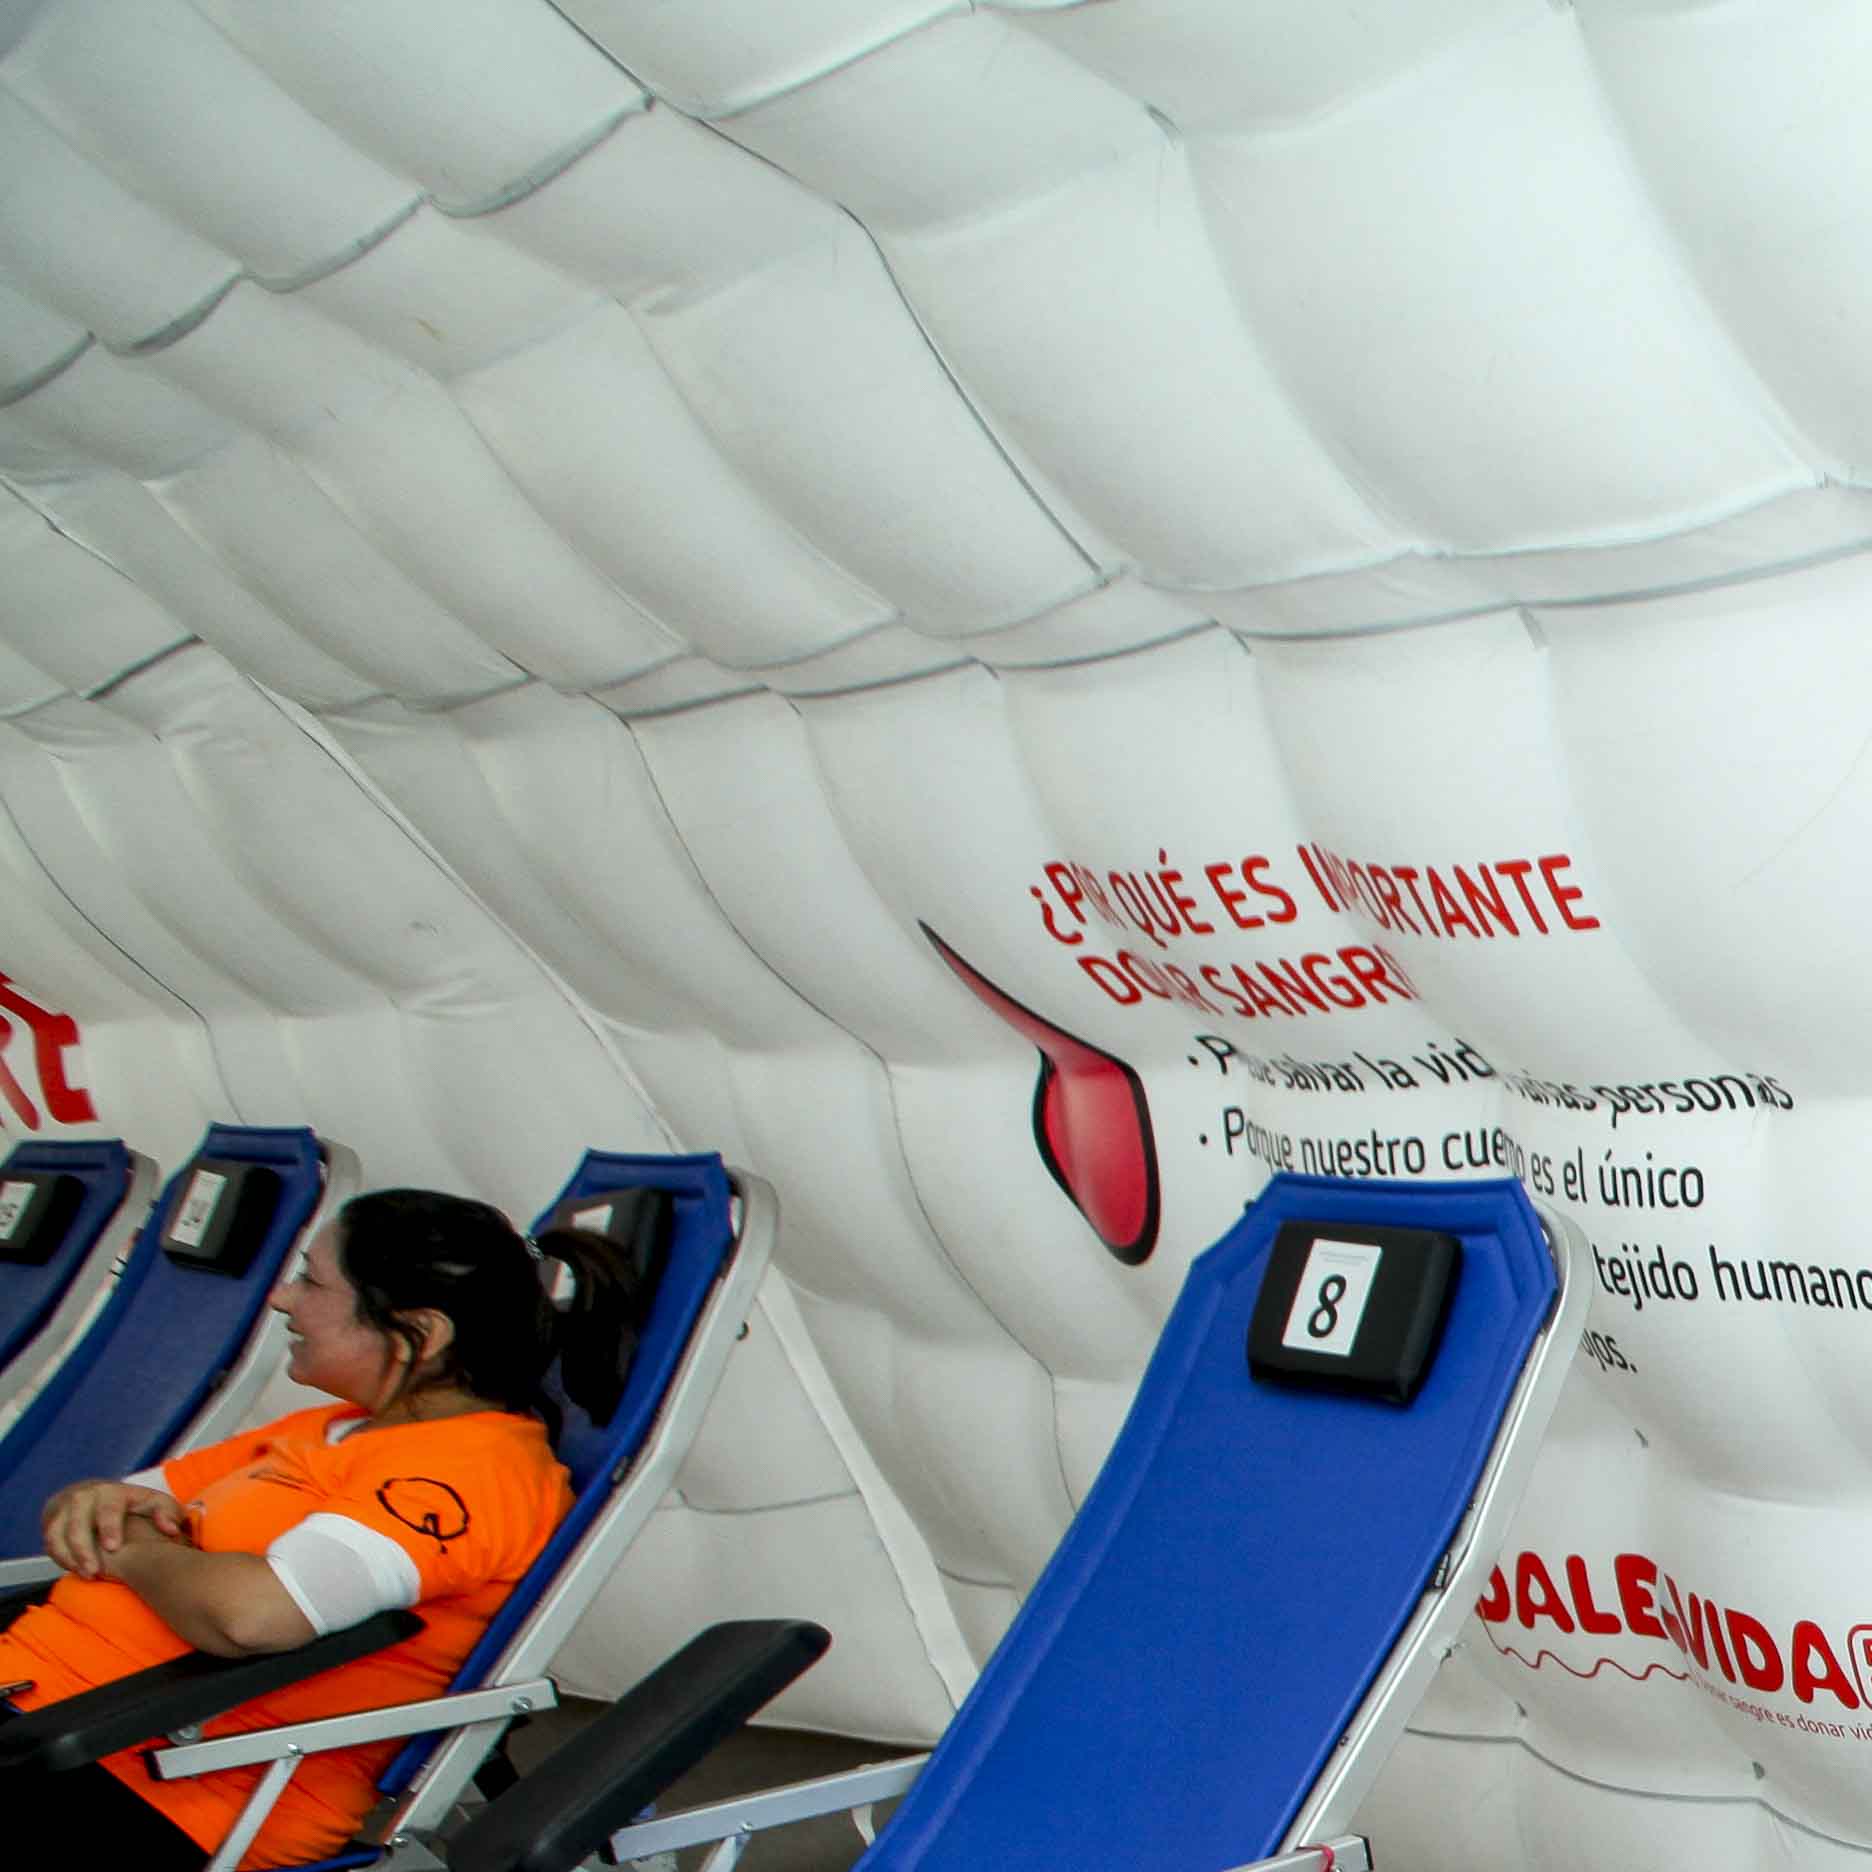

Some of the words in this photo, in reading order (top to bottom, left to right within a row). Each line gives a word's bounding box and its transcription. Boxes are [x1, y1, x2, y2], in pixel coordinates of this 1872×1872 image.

[1204, 855, 1298, 929] ES
[1352, 1051, 1420, 1090] la
[1412, 1038, 1500, 1084] vid
[1592, 1073, 1794, 1129] personas
[1300, 1128, 1426, 1176] nuestro
[1530, 1152, 1555, 1196] es
[1563, 1146, 1588, 1203] el
[1599, 1149, 1704, 1208] único
[1307, 1273, 1348, 1339] 8
[1592, 1243, 1699, 1312] tejido
[1663, 1572, 1862, 1711] VIDA
[1797, 1713, 1846, 1740] donar
